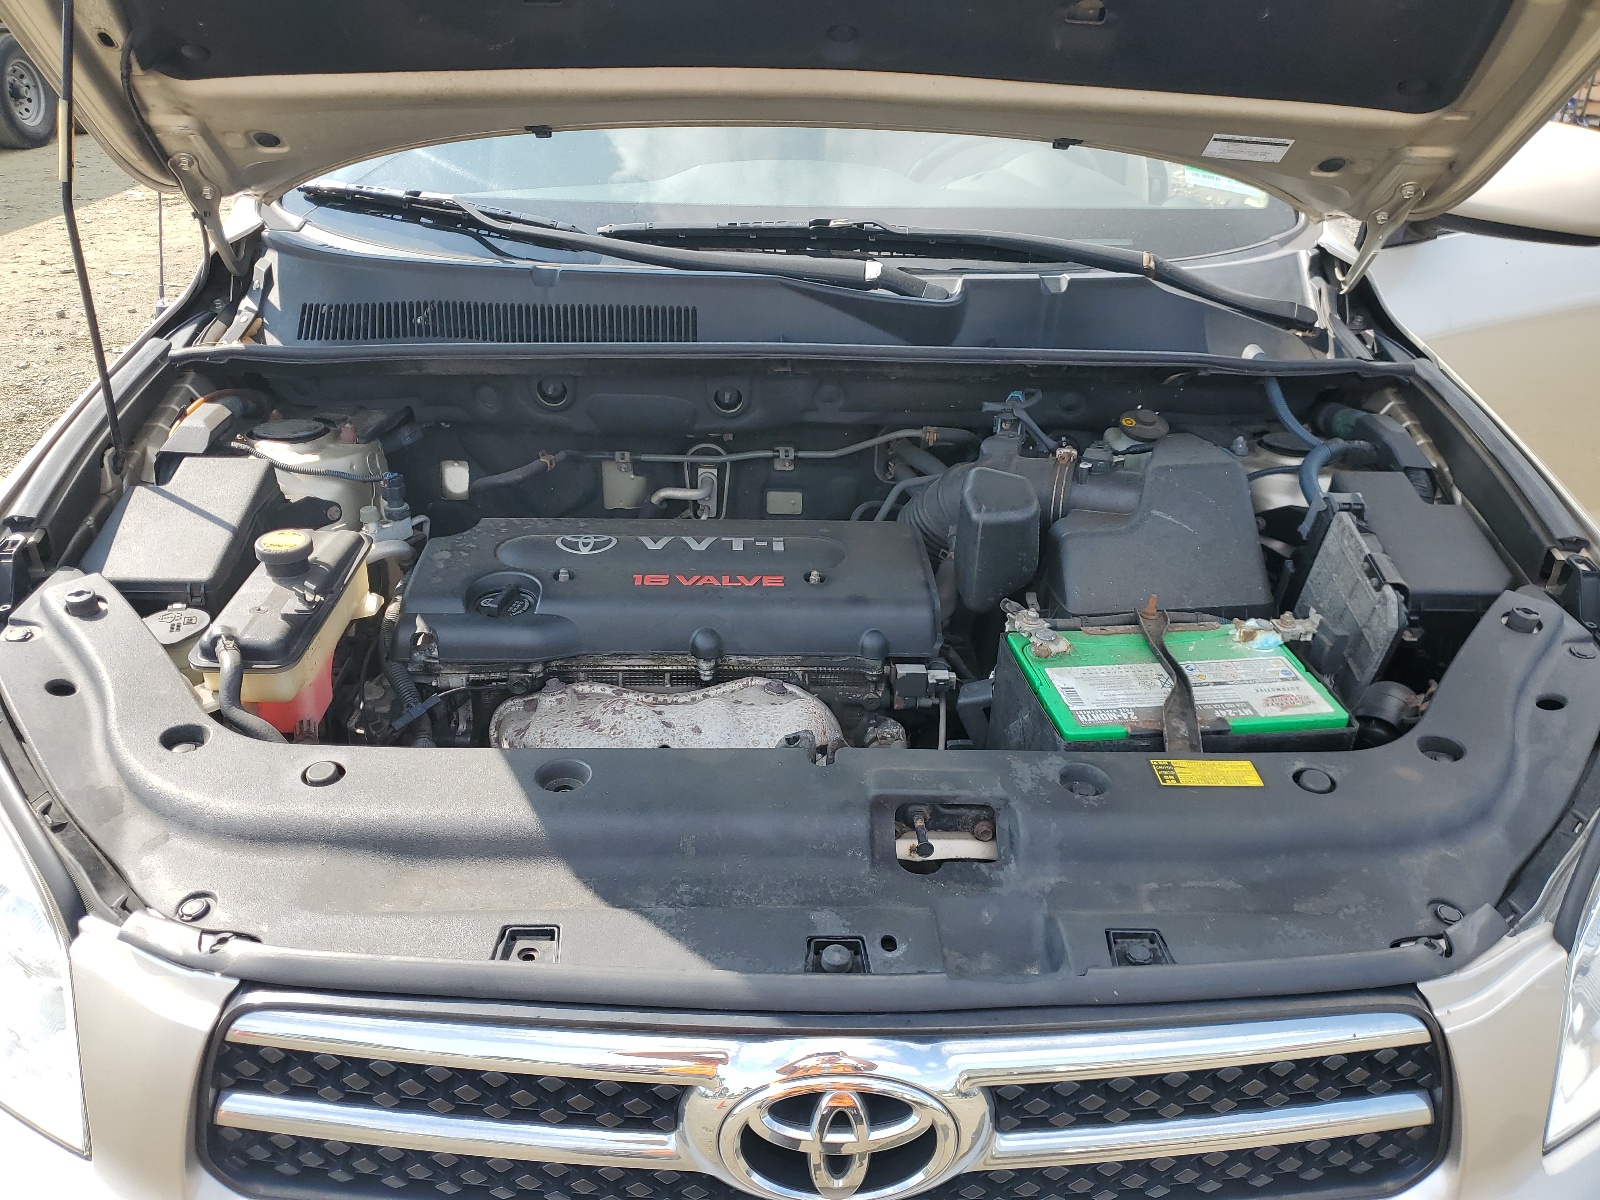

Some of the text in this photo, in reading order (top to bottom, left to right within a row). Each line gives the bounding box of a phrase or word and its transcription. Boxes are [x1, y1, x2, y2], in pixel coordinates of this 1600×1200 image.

[638, 536, 785, 551] VVT-i
[632, 574, 785, 588] 16 VALVE
[1077, 711, 1138, 722] 24-MONTH
